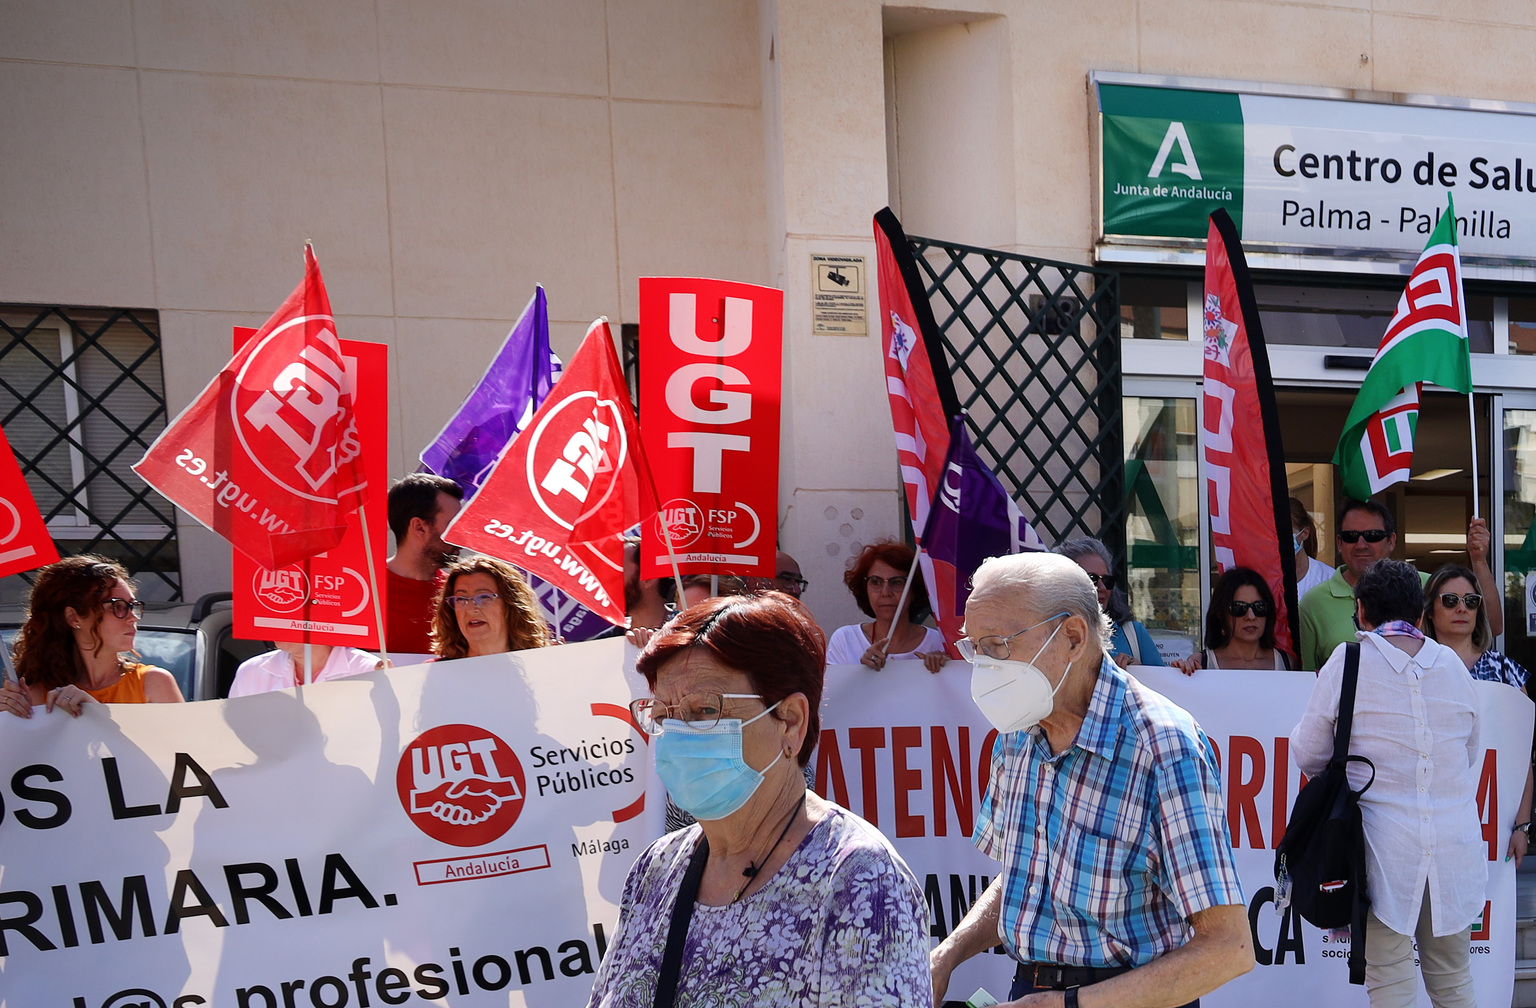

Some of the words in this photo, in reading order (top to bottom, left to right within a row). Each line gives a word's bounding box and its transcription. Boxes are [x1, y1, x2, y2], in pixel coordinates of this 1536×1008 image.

[1273, 144, 1402, 184] Centro
[1413, 152, 1458, 187] de
[1113, 182, 1149, 197] Junta
[1153, 184, 1168, 198] de
[1171, 184, 1233, 201] Andalucía
[1282, 200, 1371, 231] Palma
[665, 293, 753, 493] UGT
[663, 507, 696, 525] UGT
[708, 509, 737, 524] FSP
[261, 570, 302, 591] UGT
[315, 575, 345, 590] FSP
[412, 738, 501, 789] UGT
[530, 738, 635, 768] Servicios
[536, 767, 634, 796] Públicos
[101, 752, 229, 820] LA
[445, 856, 520, 879] Andalucía
[571, 837, 630, 858] Málaga
[0, 853, 398, 957] RIMARIA.
